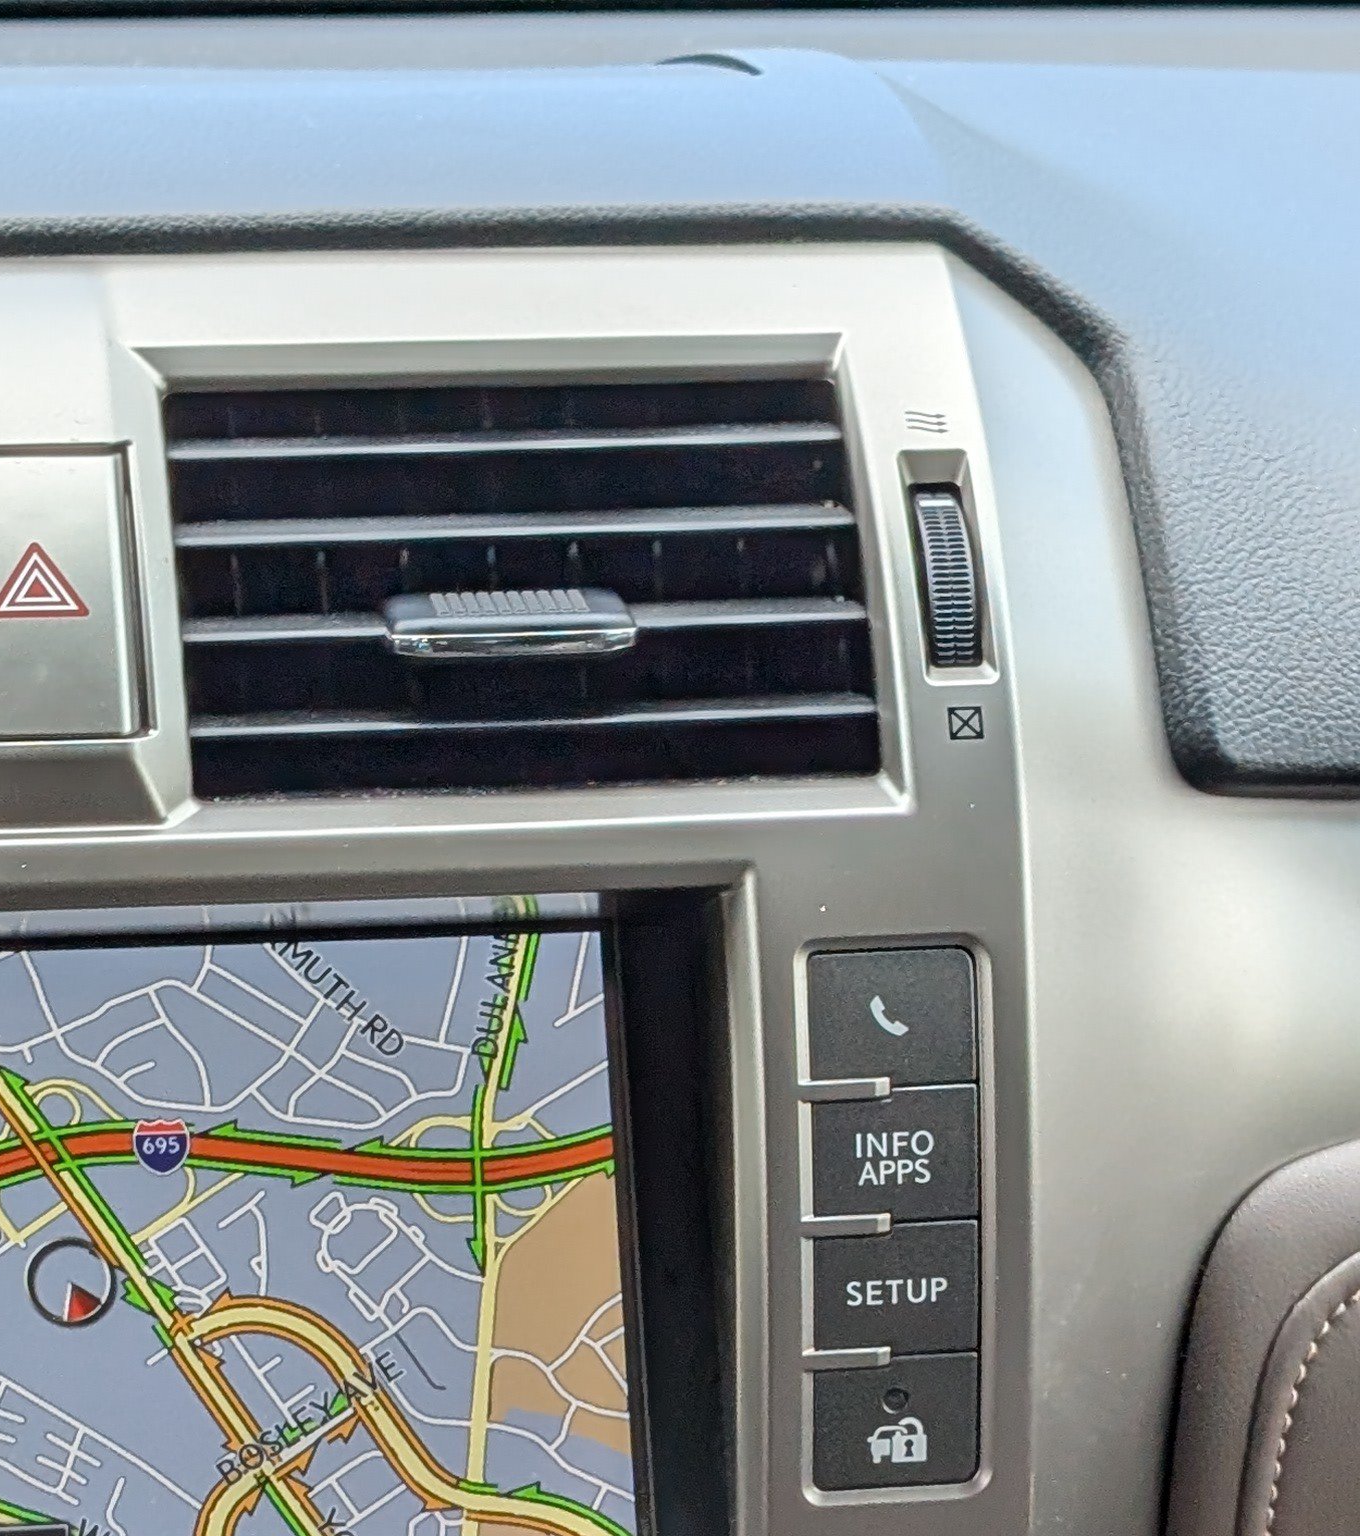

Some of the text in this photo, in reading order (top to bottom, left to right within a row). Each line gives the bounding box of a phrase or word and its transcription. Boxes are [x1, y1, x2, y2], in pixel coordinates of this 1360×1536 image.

[271, 941, 404, 1056] MUTH RD
[472, 932, 519, 1060] DULAN
[142, 1136, 180, 1155] 695
[855, 1129, 935, 1159] INFO
[858, 1158, 931, 1187] APPS
[846, 1277, 948, 1306] SETUP
[215, 1351, 405, 1486] BOSLEY AVE
